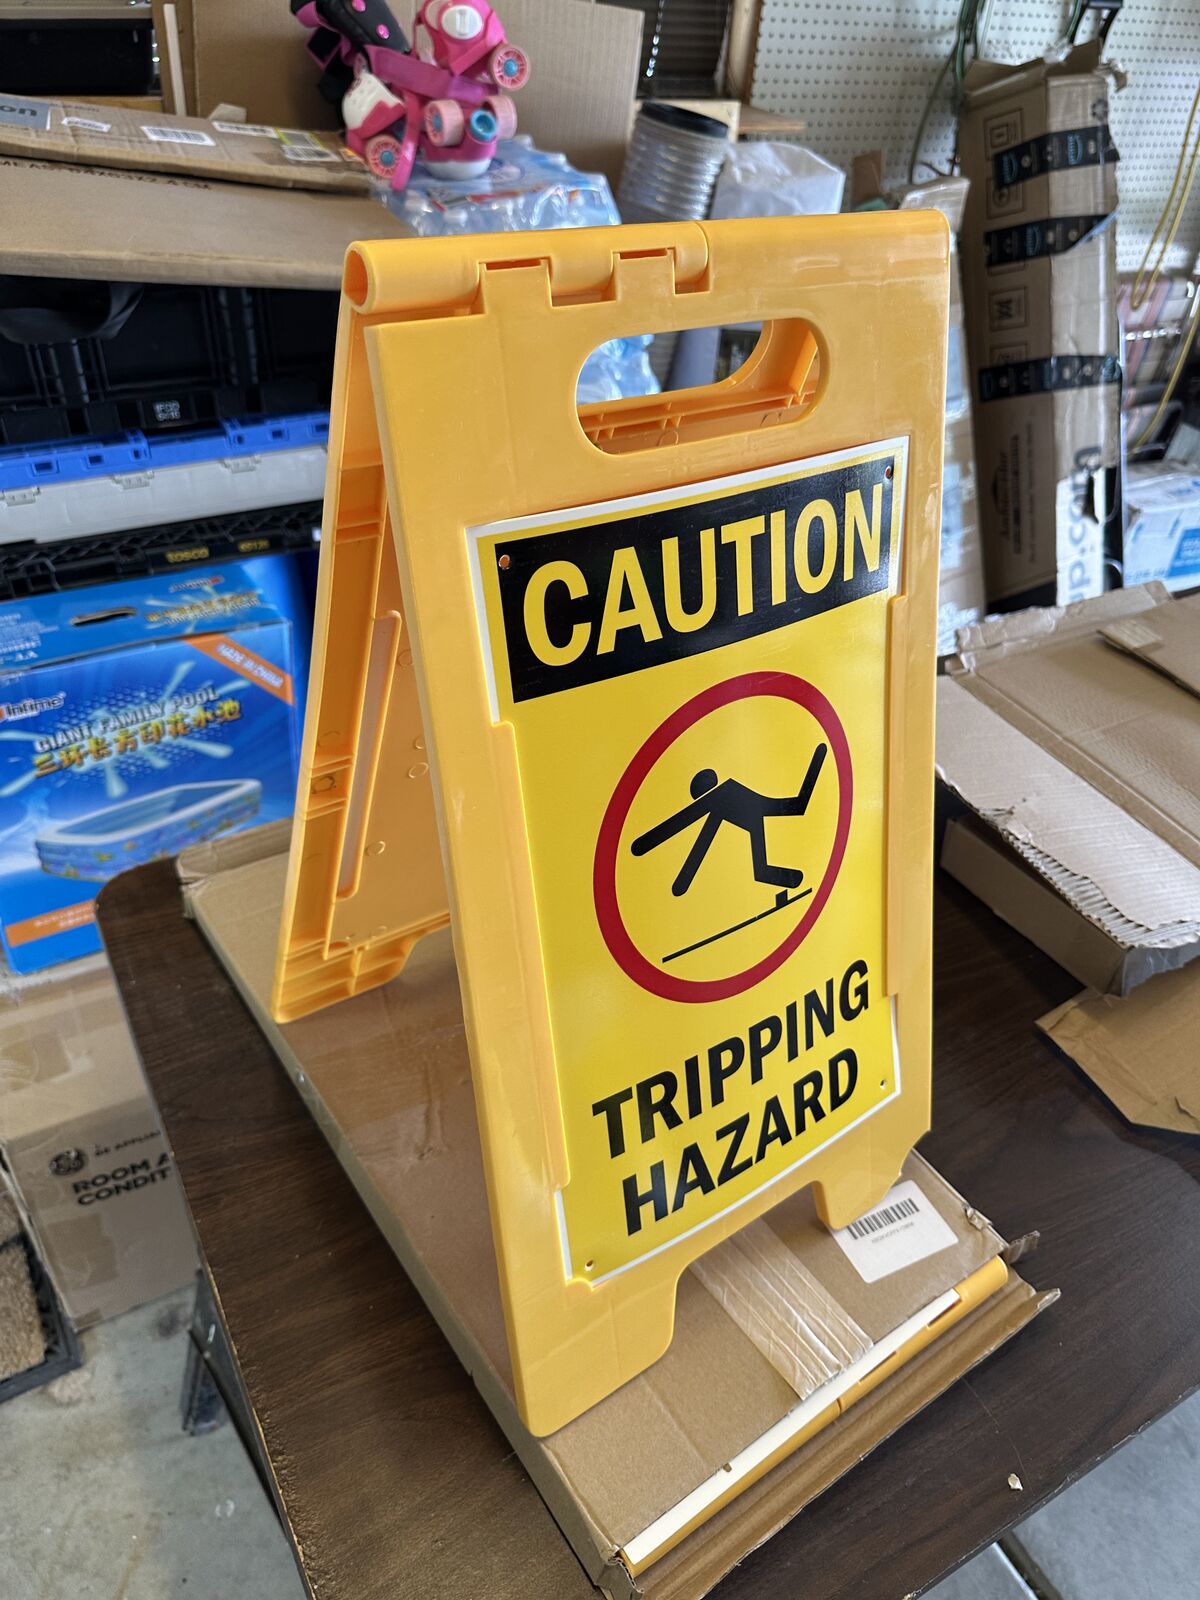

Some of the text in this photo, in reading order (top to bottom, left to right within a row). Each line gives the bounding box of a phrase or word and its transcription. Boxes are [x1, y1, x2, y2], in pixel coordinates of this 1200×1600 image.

[523, 483, 883, 667] CAUTION
[36, 685, 218, 751] GIANT FAMILY POOL
[592, 959, 869, 1160] TRIPPING
[73, 1159, 151, 1195] ROOM
[78, 1166, 171, 1206] CONDIT
[622, 1048, 858, 1237] HAZARD
